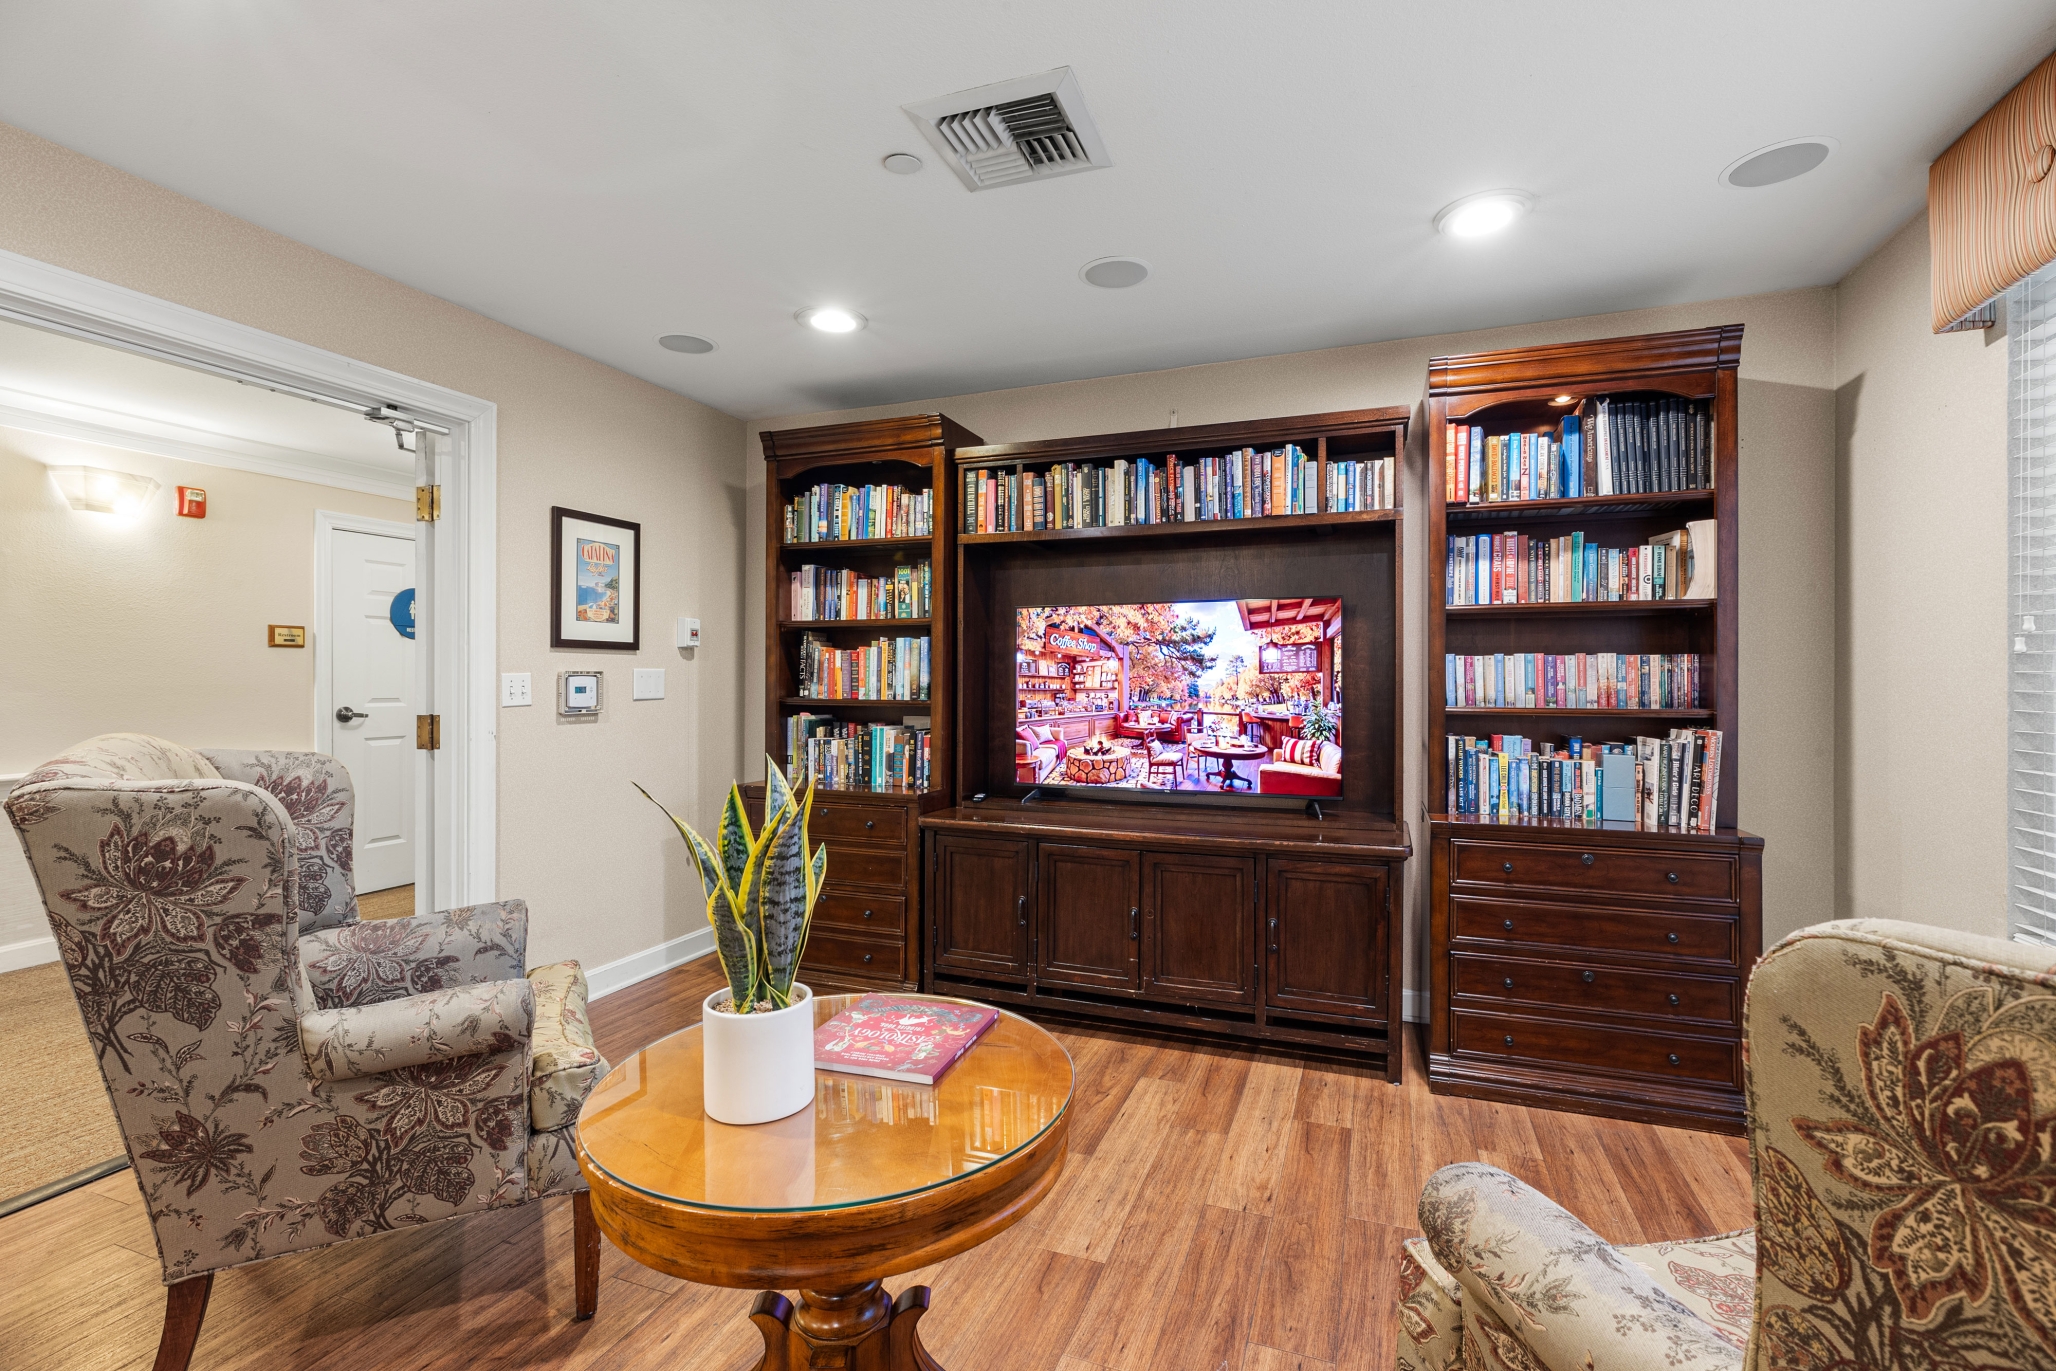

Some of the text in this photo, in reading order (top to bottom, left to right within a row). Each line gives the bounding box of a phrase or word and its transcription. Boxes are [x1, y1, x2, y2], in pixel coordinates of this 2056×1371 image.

[1585, 415, 1595, 463] We Americans
[1491, 444, 1499, 484] DAVID BALDACCI
[1522, 468, 1528, 476] Z
[967, 484, 976, 515] CHURCHILL
[581, 544, 615, 563] CATALINA
[1494, 536, 1502, 572] ROBERT CRAIS
[1049, 633, 1097, 653] Coffee Shop
[1706, 736, 1717, 795] MODERN LOCOMOTIVES
[1690, 766, 1701, 812] ART DECO
[848, 1027, 934, 1046] ASTROLOGY
[879, 1021, 925, 1032] COLORING BOOK
